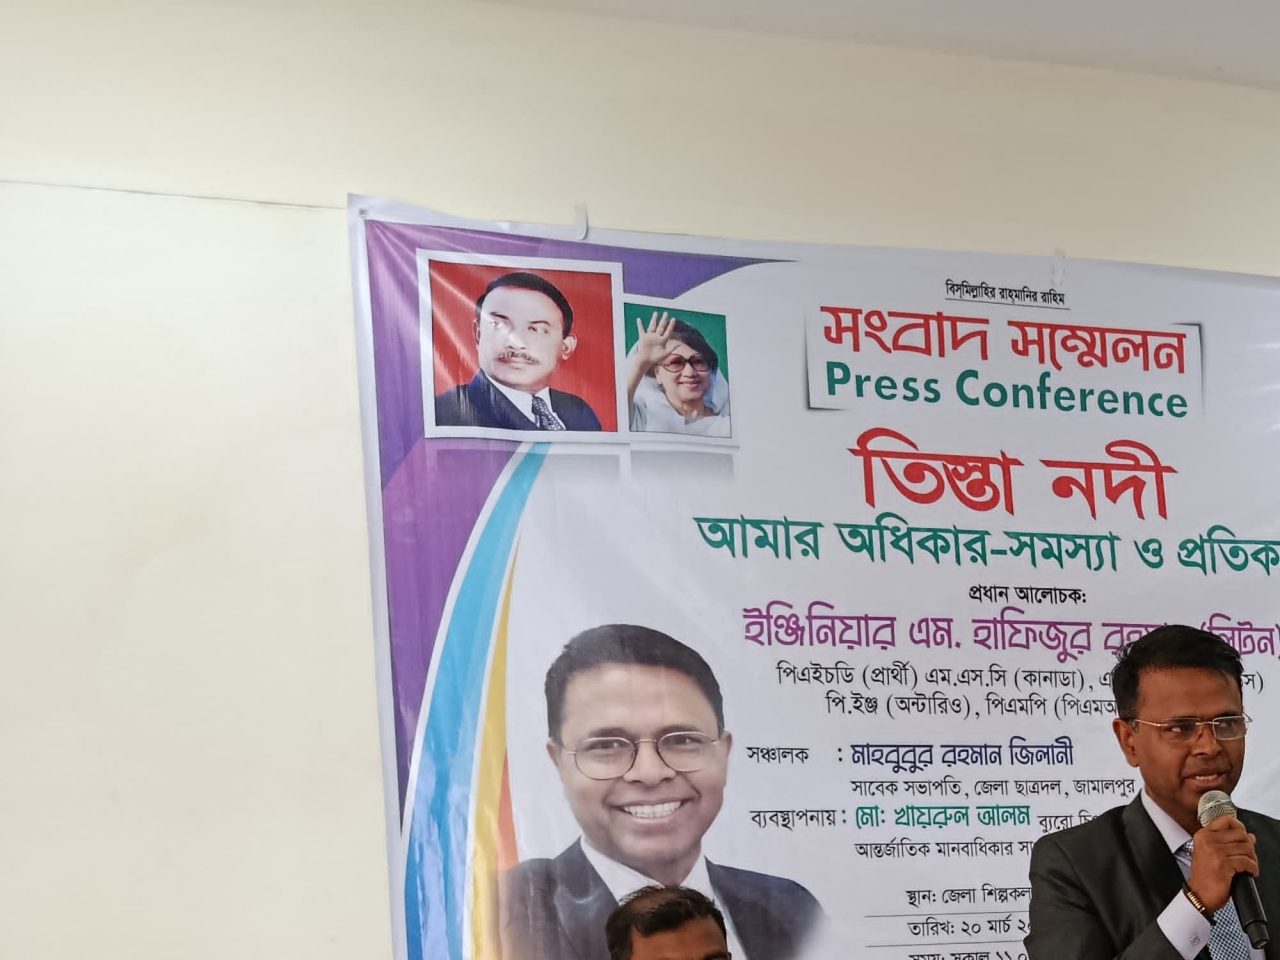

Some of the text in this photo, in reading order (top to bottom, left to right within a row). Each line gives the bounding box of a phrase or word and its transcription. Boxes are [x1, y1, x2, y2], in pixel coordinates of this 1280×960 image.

[1040, 288, 1065, 304] রাহিম
[820, 306, 1186, 373] সংবাদ সম্মেলন
[826, 361, 1188, 418] Press Conference
[847, 427, 1178, 520] তিস্তা নদী
[693, 514, 824, 560] আমার
[1134, 536, 1163, 569] ও
[968, 585, 1087, 604] প্রধান আলোচক:
[743, 601, 897, 649] ইঞ্জিনিয়ার
[909, 617, 962, 649] এম.
[971, 606, 1092, 664] হাফিজুর
[776, 660, 855, 685] পিএইচডি
[862, 660, 918, 690] (প্রার্থী)
[925, 664, 1007, 687] এম.এস.সি
[986, 693, 1047, 715] পিএমপি
[746, 746, 809, 764] সঞ্চালক
[851, 736, 1074, 773] মাহবুবুর রহমান জিলানী
[850, 780, 898, 796] সাবেক
[974, 780, 1010, 796] জেলা
[1073, 779, 1135, 797] জামালপুর
[976, 804, 1031, 827] আলম
[854, 836, 930, 859] আন্তর্জাতিক
[935, 836, 1013, 858] মানবাধিকার
[942, 888, 976, 904] জেলা
[907, 916, 955, 936] তারিখ:
[961, 921, 981, 936] ২০
[987, 913, 1012, 934] মার্চ
